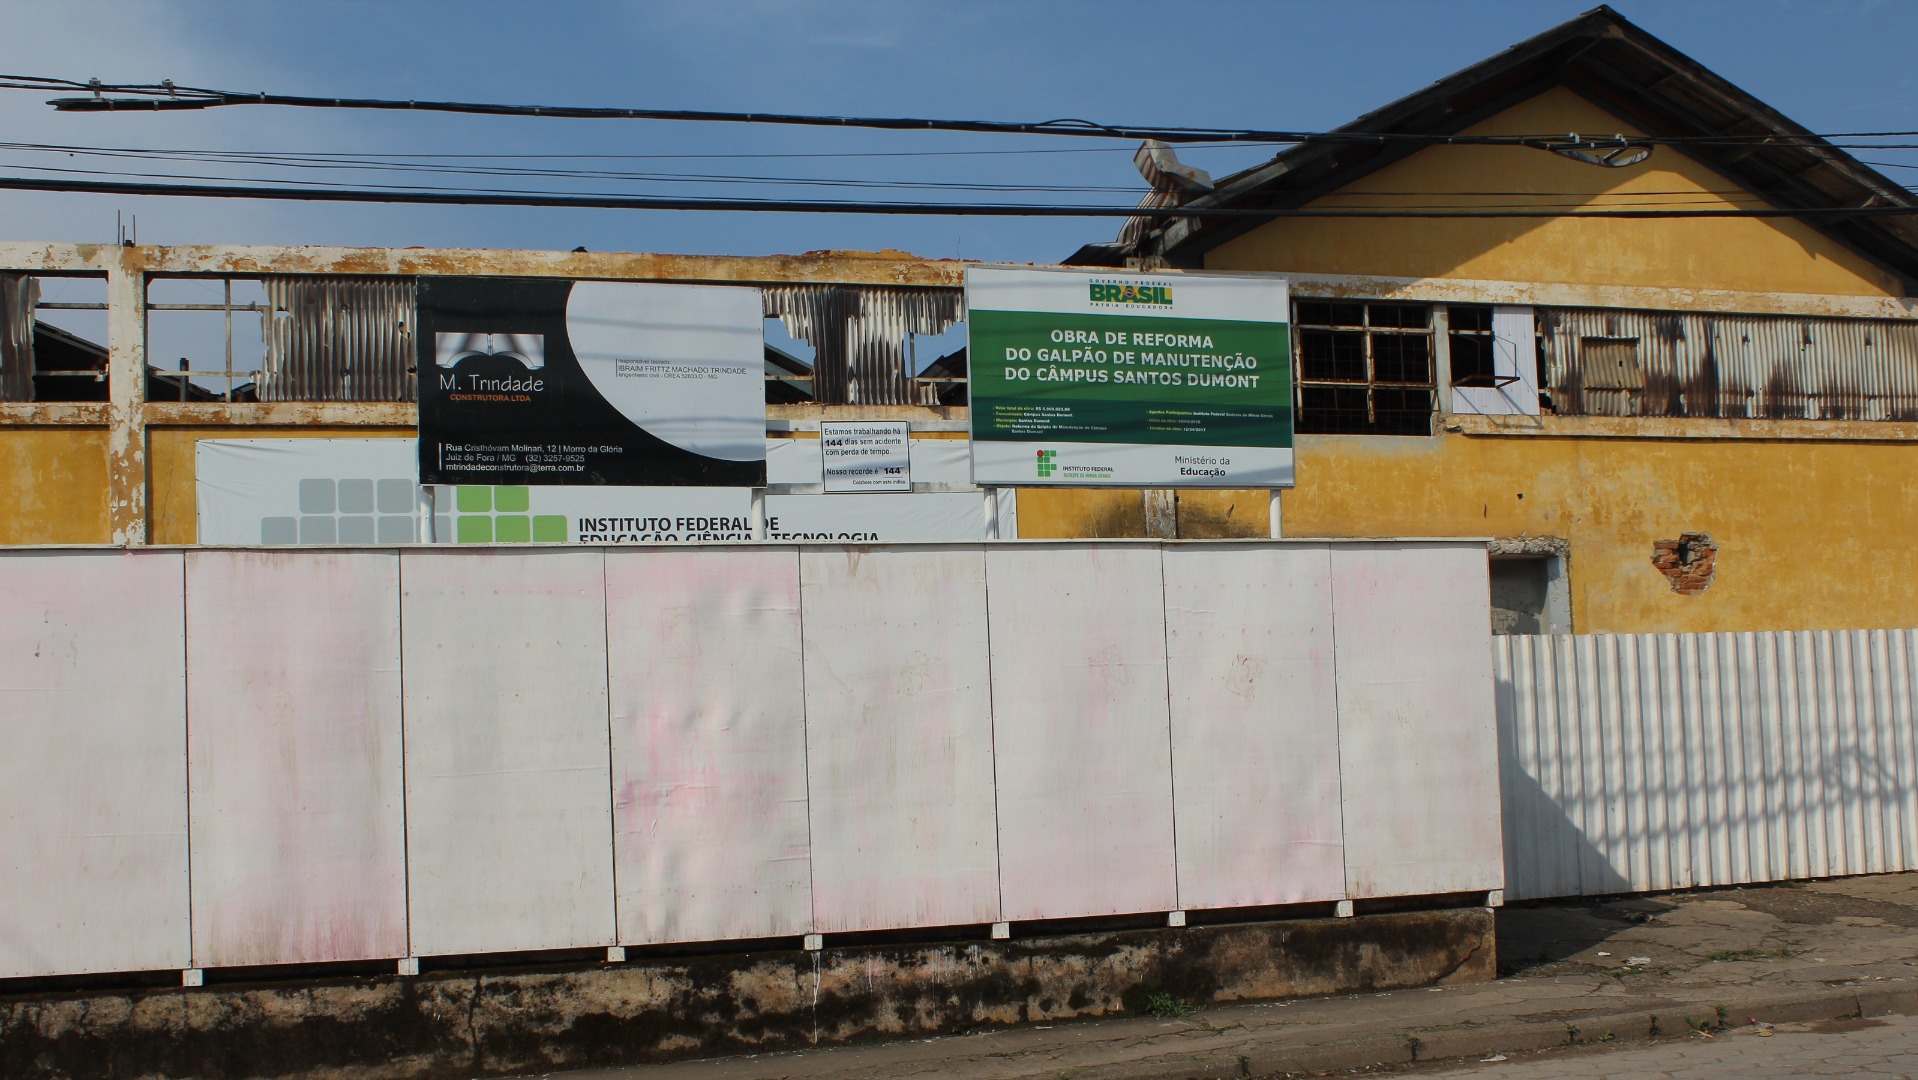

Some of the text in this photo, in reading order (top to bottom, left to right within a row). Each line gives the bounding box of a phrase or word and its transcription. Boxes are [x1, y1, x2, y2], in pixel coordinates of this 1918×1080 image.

[1090, 284, 1173, 304] BRASIL
[1050, 330, 1214, 348] OBRA DE REFORMA
[1006, 346, 1257, 371] DO GALPÃO DE MANUTENÇÃO
[1005, 365, 1260, 388] DO CÂMPUS SANTOS DUMONT
[440, 374, 544, 392] M. Trindade
[450, 394, 510, 402] CONSTRUTORA
[446, 443, 462, 452] Rua
[600, 445, 623, 453] Glória
[841, 449, 859, 457] perda
[525, 454, 541, 463] (32)
[1175, 456, 1230, 465] Ministério da
[446, 464, 585, 473] mtrindadeconstrutora@terra.com.br
[1180, 467, 1226, 477] Educação
[579, 517, 779, 532] INSTITUTO FEDERAL E
